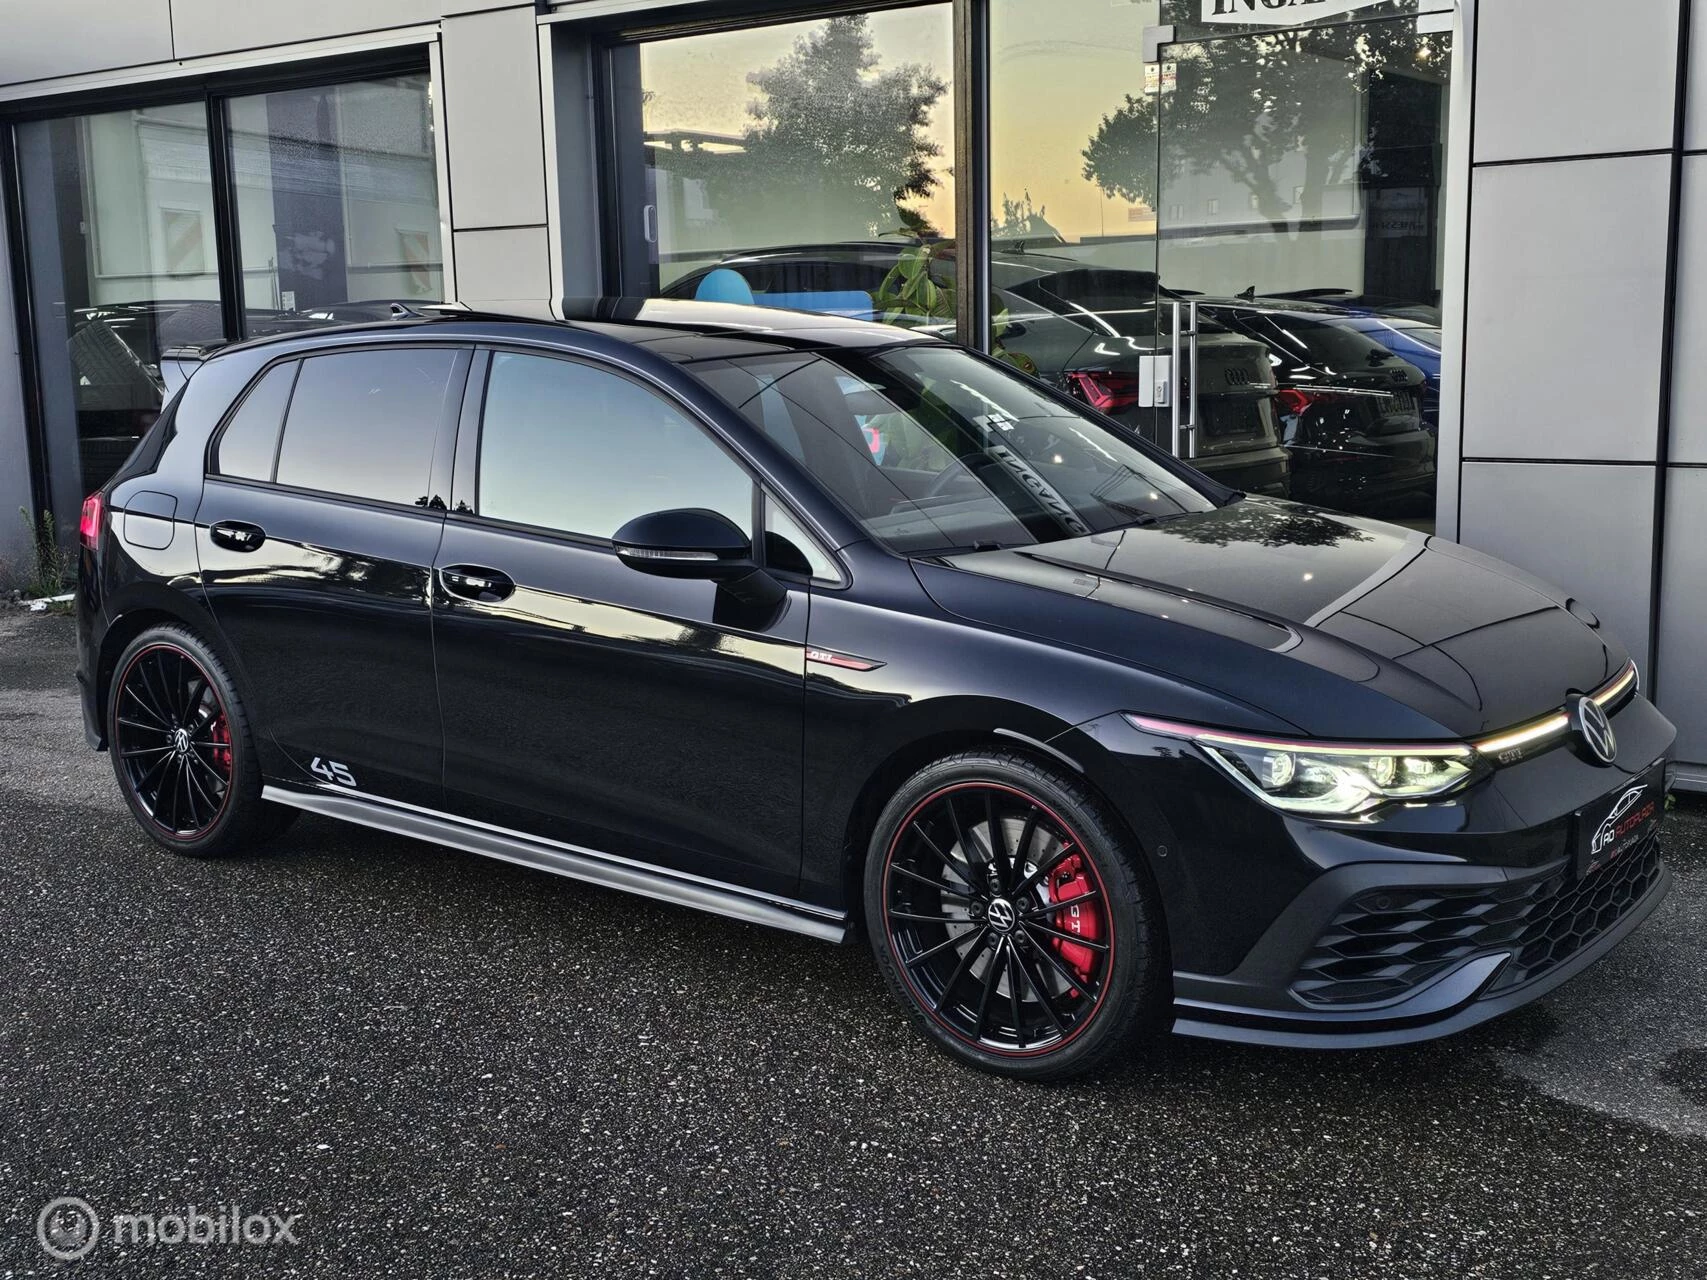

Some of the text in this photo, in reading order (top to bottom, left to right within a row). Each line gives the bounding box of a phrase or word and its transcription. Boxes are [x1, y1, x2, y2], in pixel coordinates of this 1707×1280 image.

[811, 650, 832, 661] GTI
[1498, 747, 1522, 764] GTI
[310, 756, 357, 787] 45
